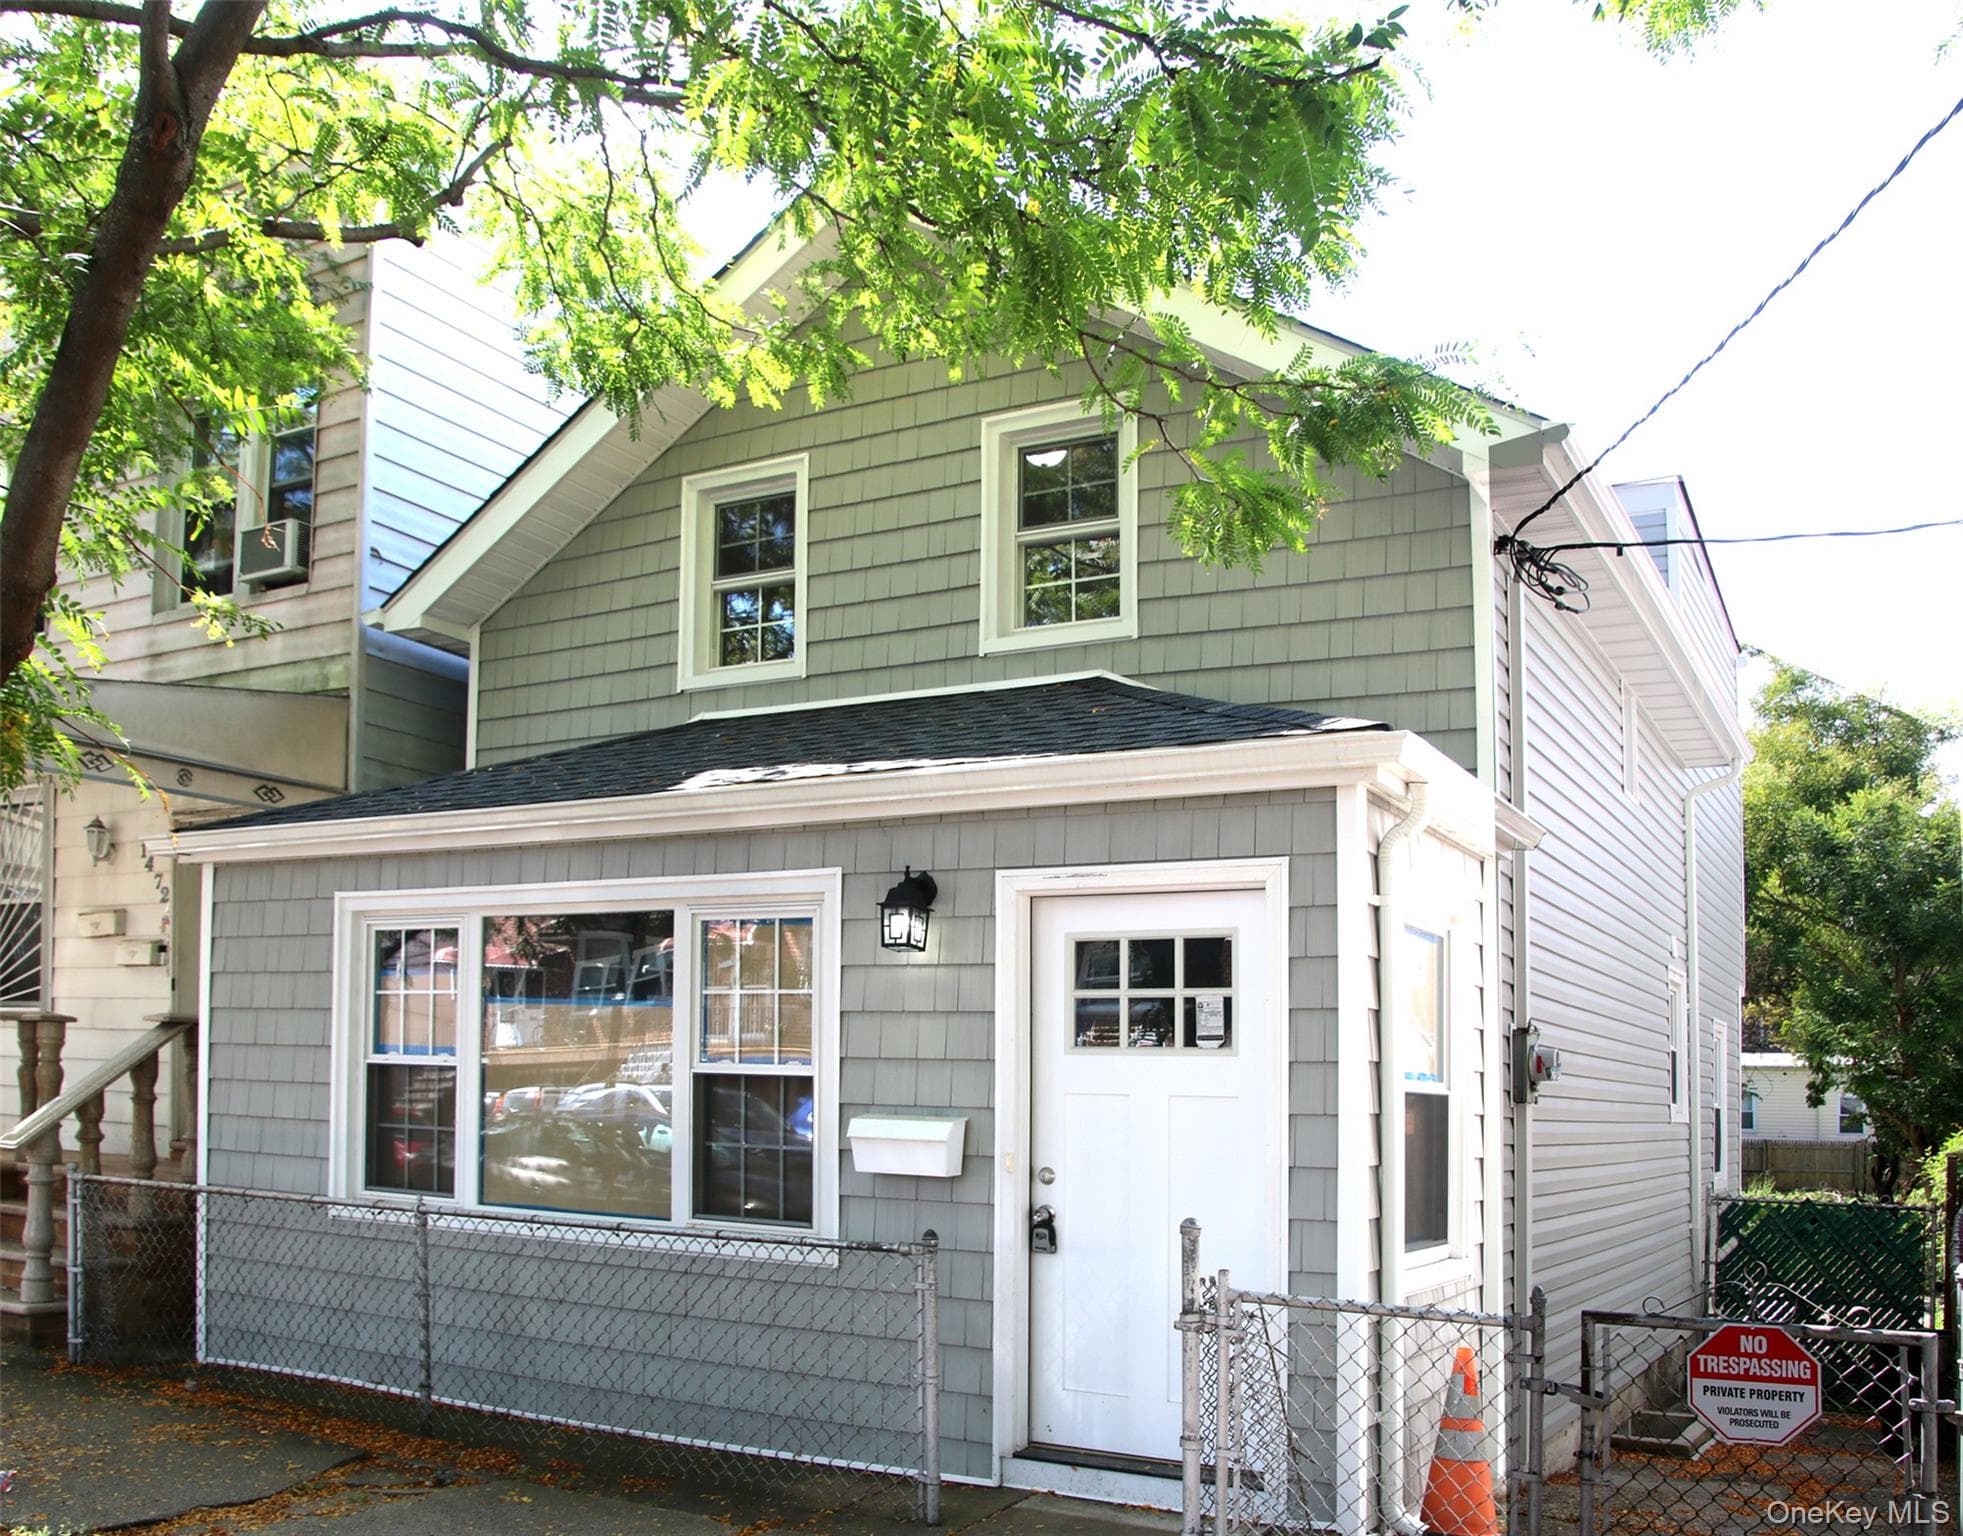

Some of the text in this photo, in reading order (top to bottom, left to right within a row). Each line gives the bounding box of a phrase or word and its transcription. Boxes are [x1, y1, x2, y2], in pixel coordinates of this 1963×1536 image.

[141, 842, 170, 904] 1472
[1739, 1335, 1768, 1354] NO
[1697, 1354, 1811, 1379] TRESPASSING
[1703, 1385, 1805, 1402] PRIVATE PROPERTY
[1717, 1406, 1791, 1420] VIOLATORS WILL BE
[1729, 1418, 1780, 1429] PROSECUTED
